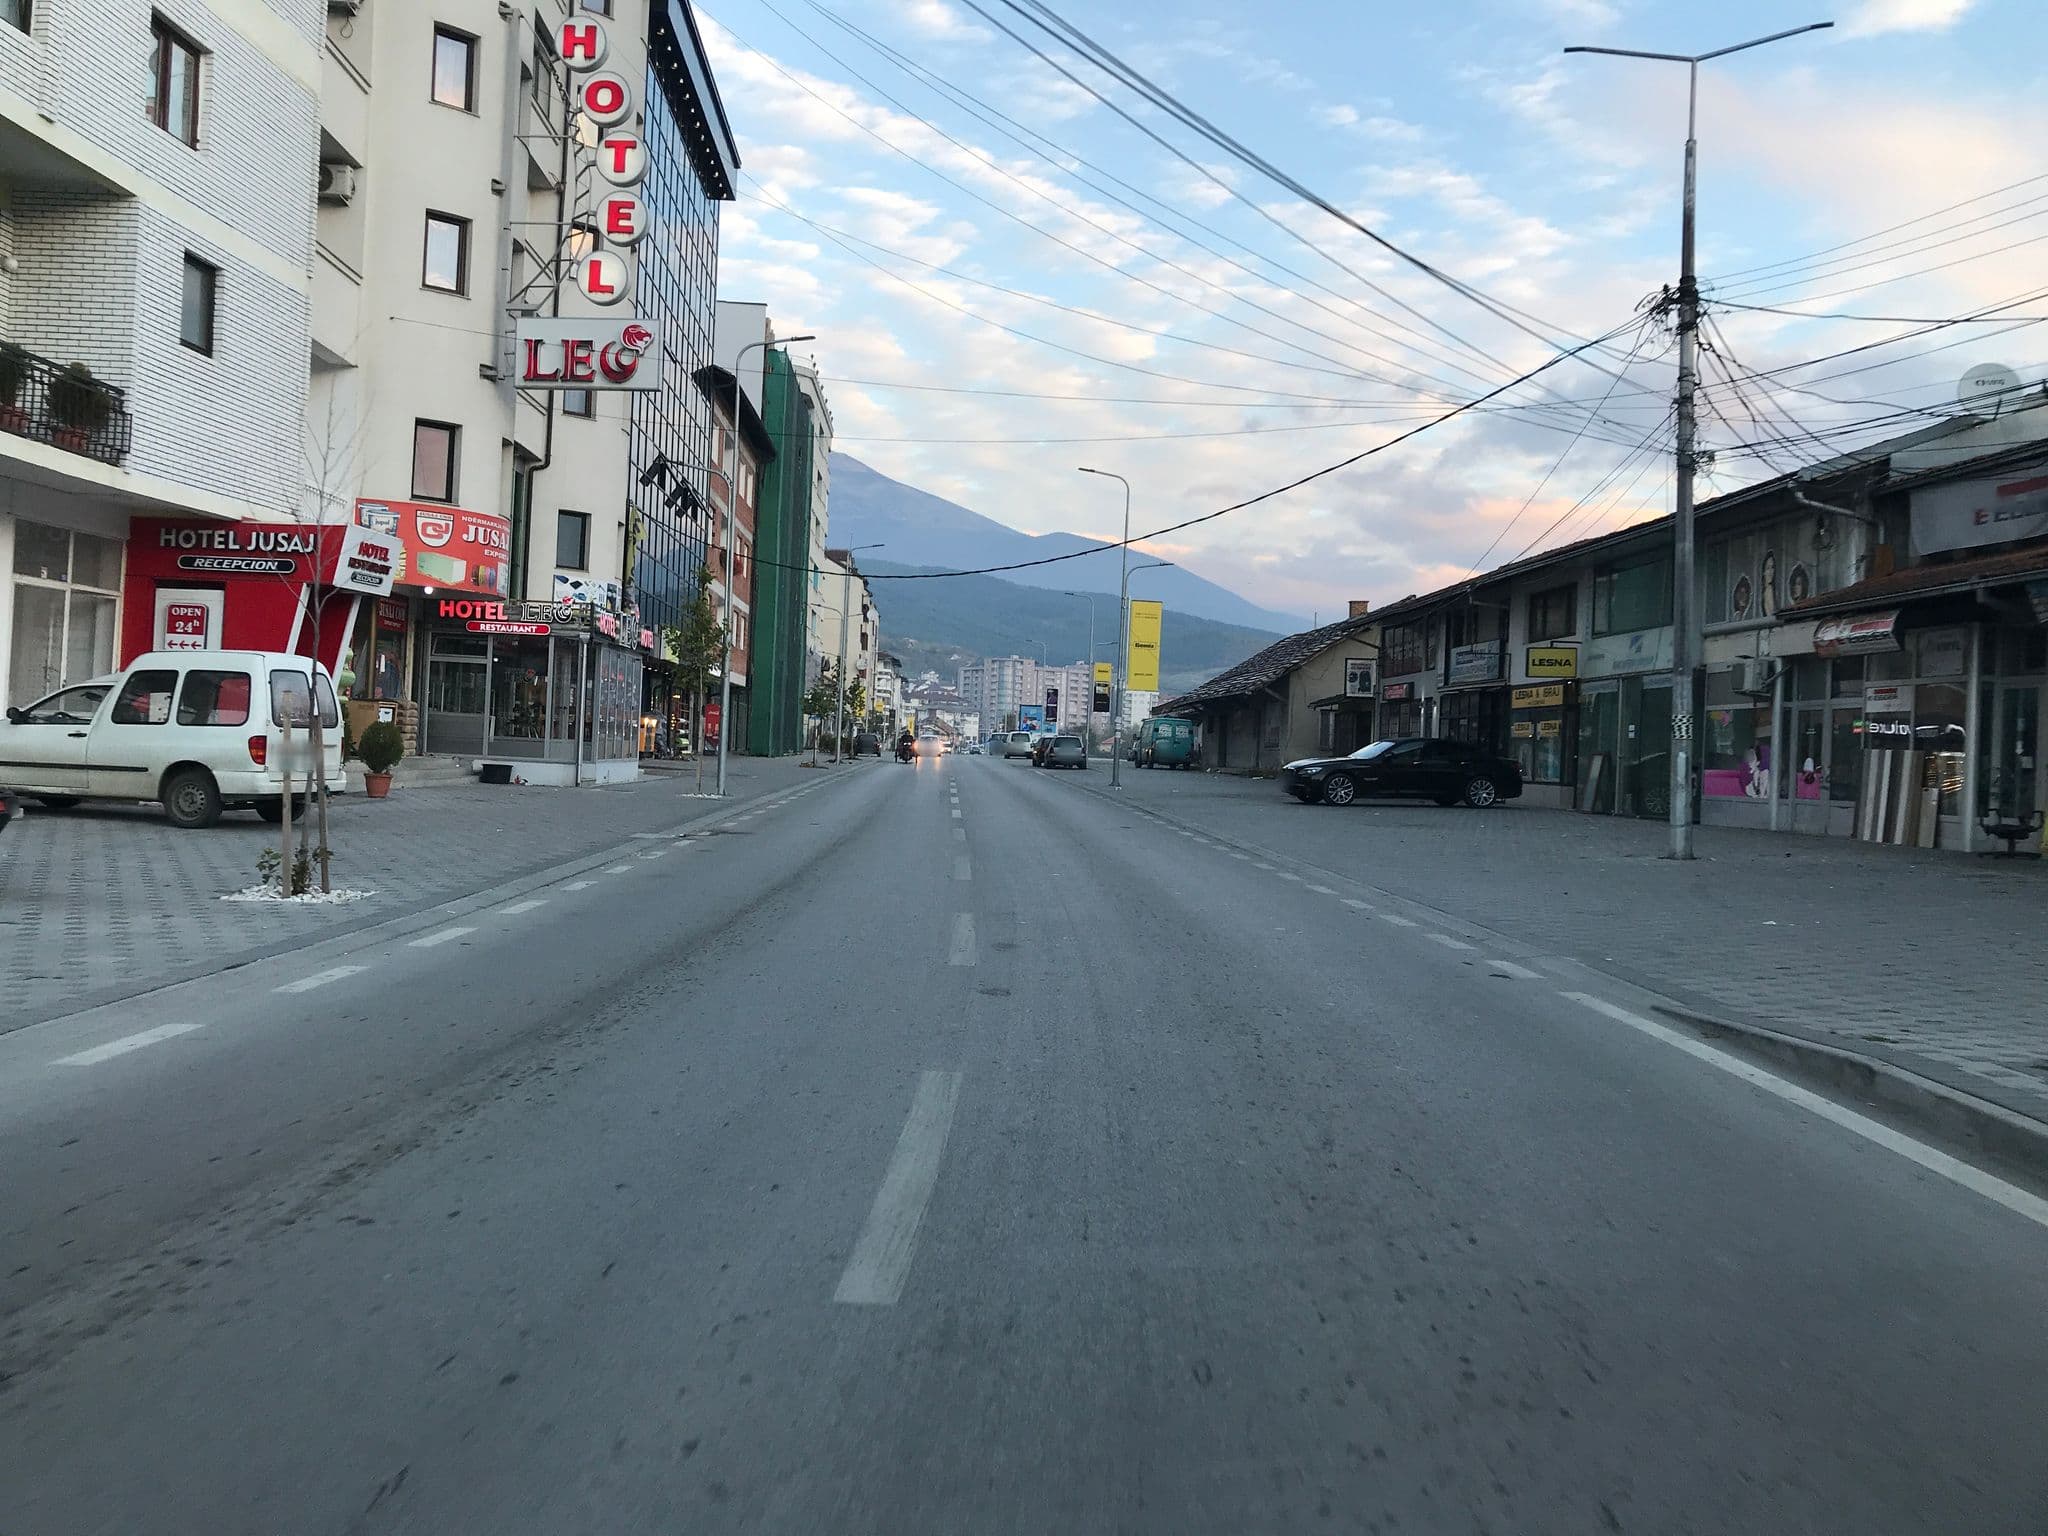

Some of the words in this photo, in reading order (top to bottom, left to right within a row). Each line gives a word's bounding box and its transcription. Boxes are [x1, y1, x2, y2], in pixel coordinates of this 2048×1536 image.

[562, 24, 637, 294] HOTEL
[159, 528, 240, 550] HOTEL
[247, 531, 315, 553] JUSAJ
[193, 557, 279, 571] RECEPCION
[171, 607, 201, 617] OPEN
[439, 599, 509, 621] HOTEL
[175, 619, 200, 633] 24h
[479, 623, 538, 634] RESTAURANT
[1531, 658, 1573, 667] LESNA
